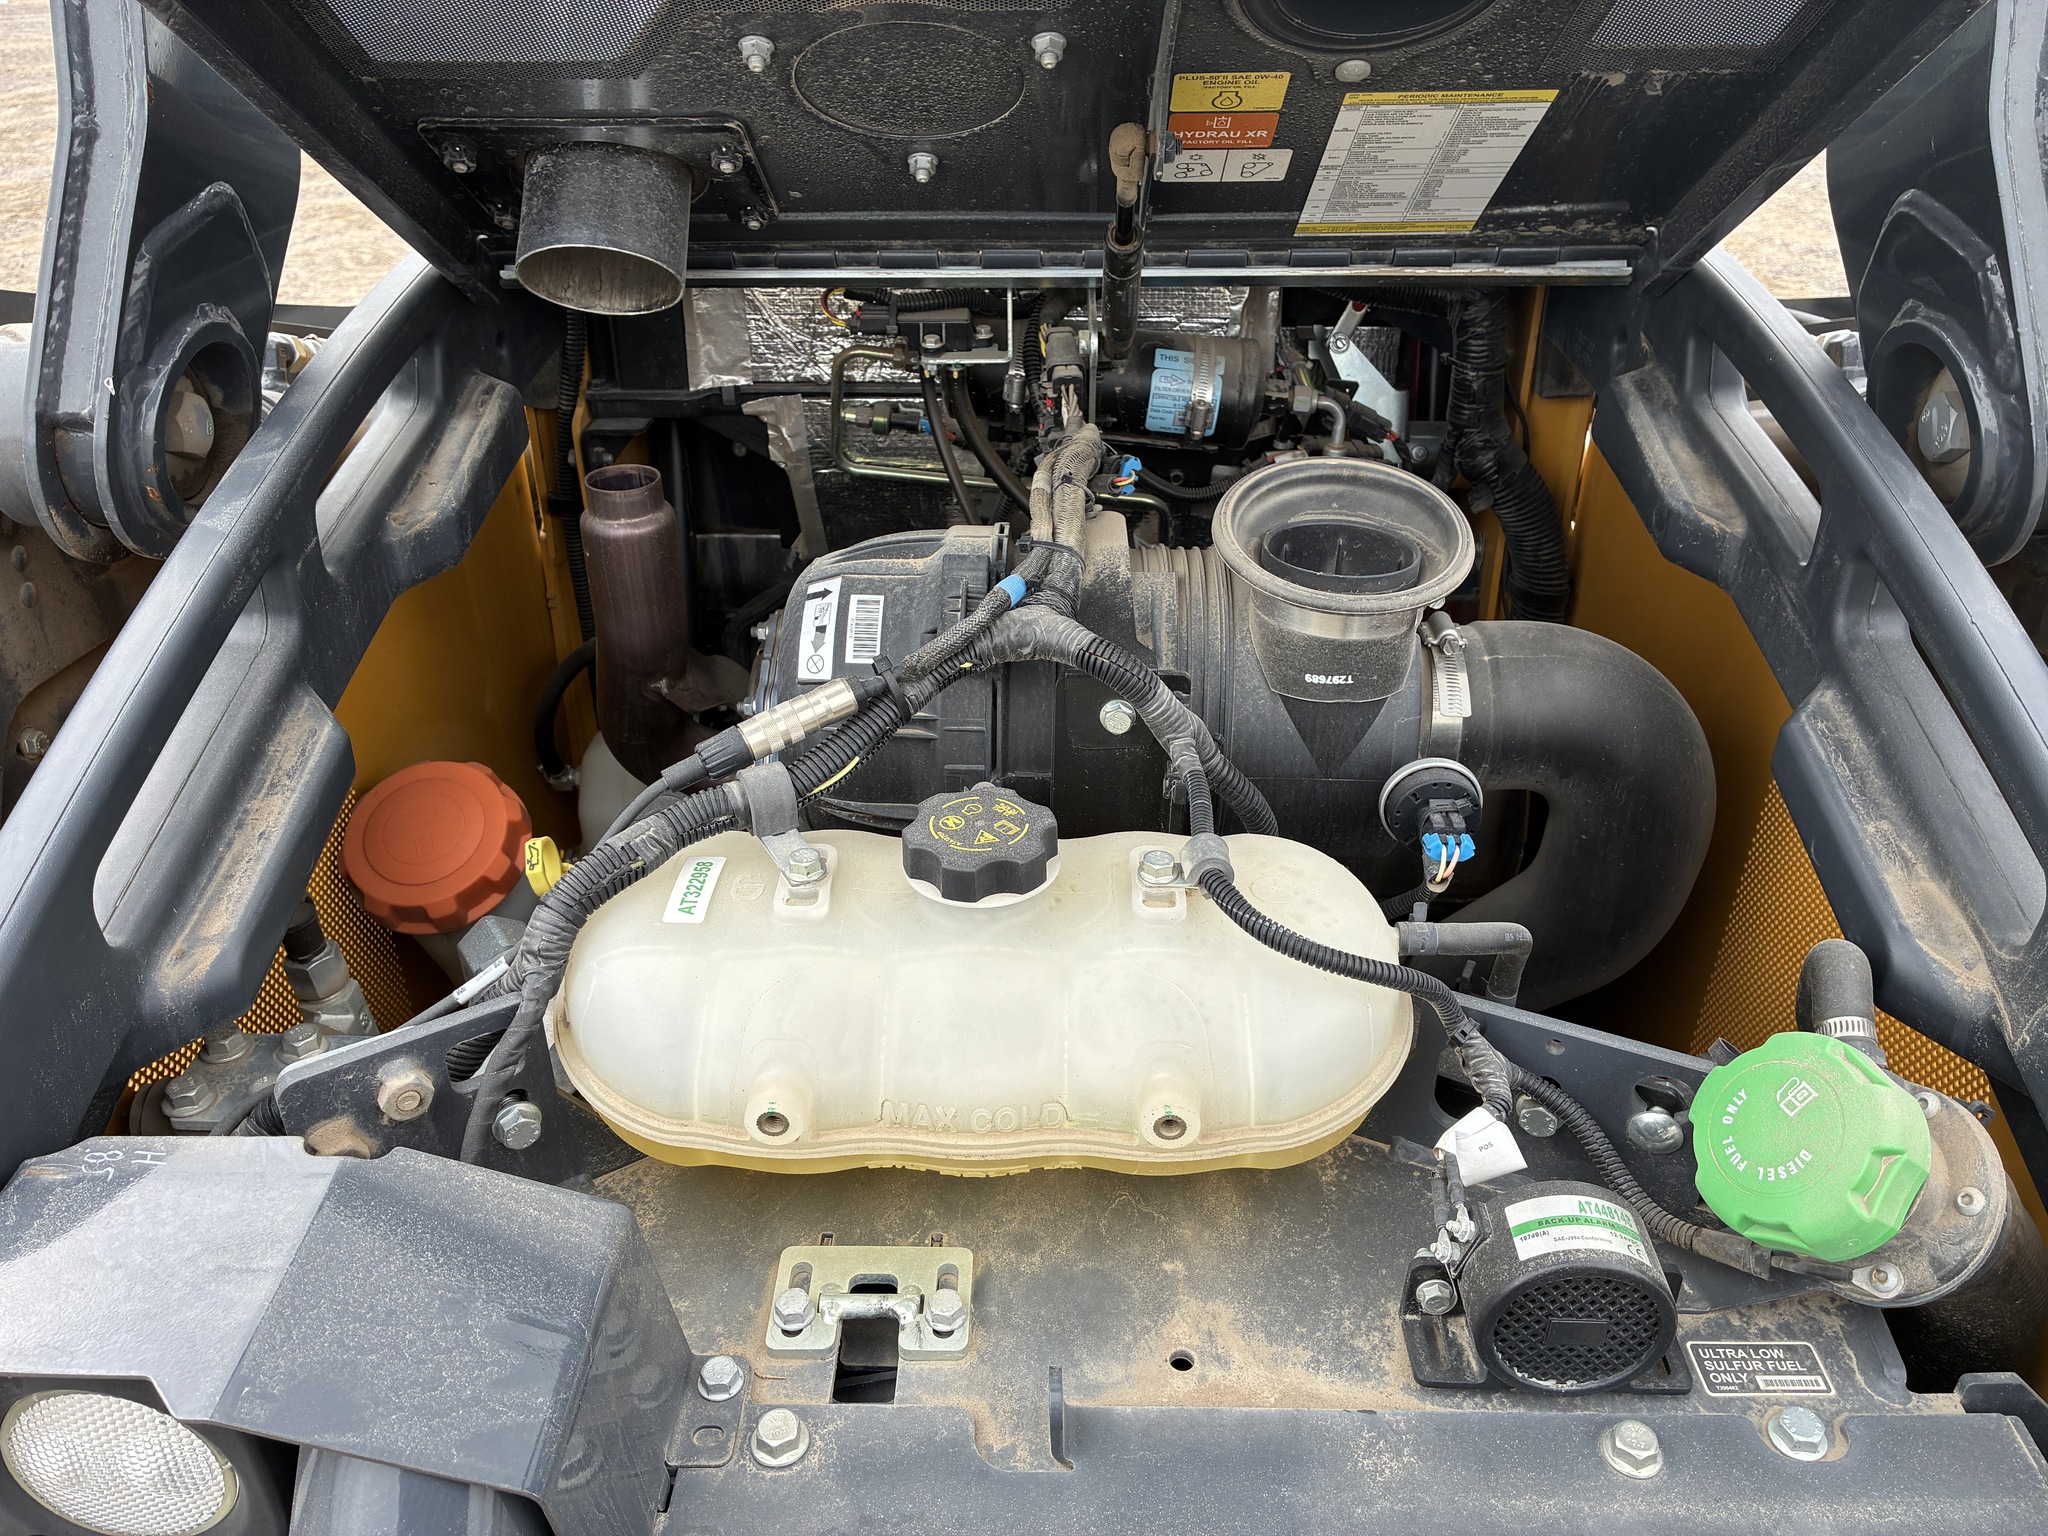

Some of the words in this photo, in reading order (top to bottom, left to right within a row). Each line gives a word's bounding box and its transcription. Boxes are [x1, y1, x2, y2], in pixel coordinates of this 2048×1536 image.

[1174, 130, 1241, 138] HYDRAU
[1159, 353, 1179, 363] THIS
[1304, 673, 1354, 685] T297689
[677, 861, 714, 916] AT322958
[1721, 1088, 1748, 1125] ONLY
[881, 1099, 958, 1133] MAX
[969, 1101, 1066, 1134] COLD
[1478, 1141, 1494, 1152] POS
[1721, 1135, 1748, 1172] FUEL
[1756, 1148, 1813, 1181] DIESEL
[1537, 1217, 1581, 1227] BACK-UP
[1584, 1217, 1616, 1229] ALARM
[1699, 1348, 1749, 1359] ULTRA
[1750, 1348, 1784, 1359] LOW
[1704, 1360, 1765, 1371] SULFUR
[1766, 1360, 1807, 1371] FUEL
[1709, 1372, 1748, 1383] ONLY
